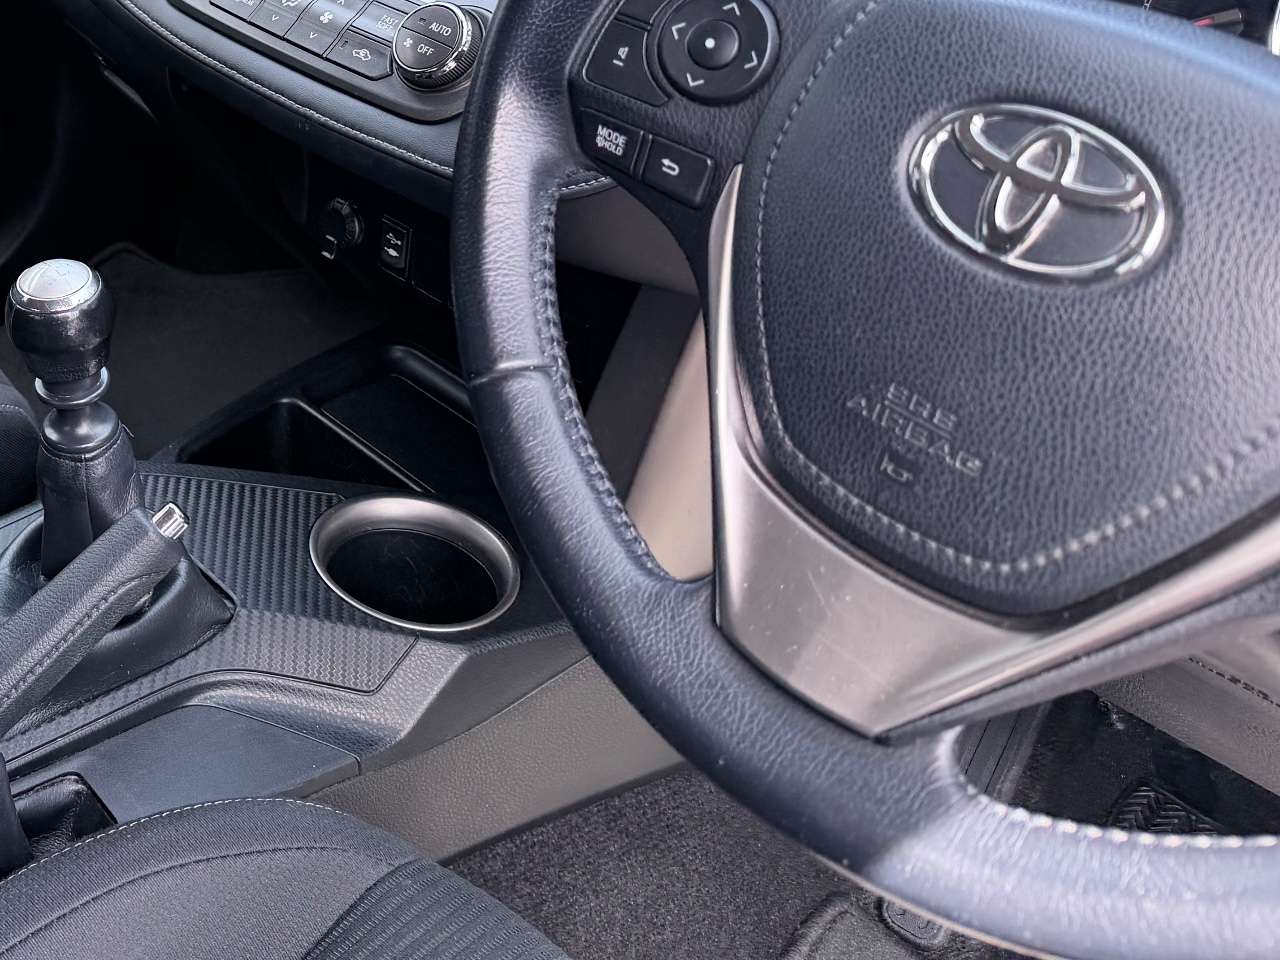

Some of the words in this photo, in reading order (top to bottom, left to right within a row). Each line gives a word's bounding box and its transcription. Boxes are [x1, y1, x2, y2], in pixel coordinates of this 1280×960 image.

[429, 22, 452, 37] AUTO
[417, 43, 435, 56] OFF
[597, 124, 628, 148] MODE
[847, 394, 983, 477] AIRBAG
